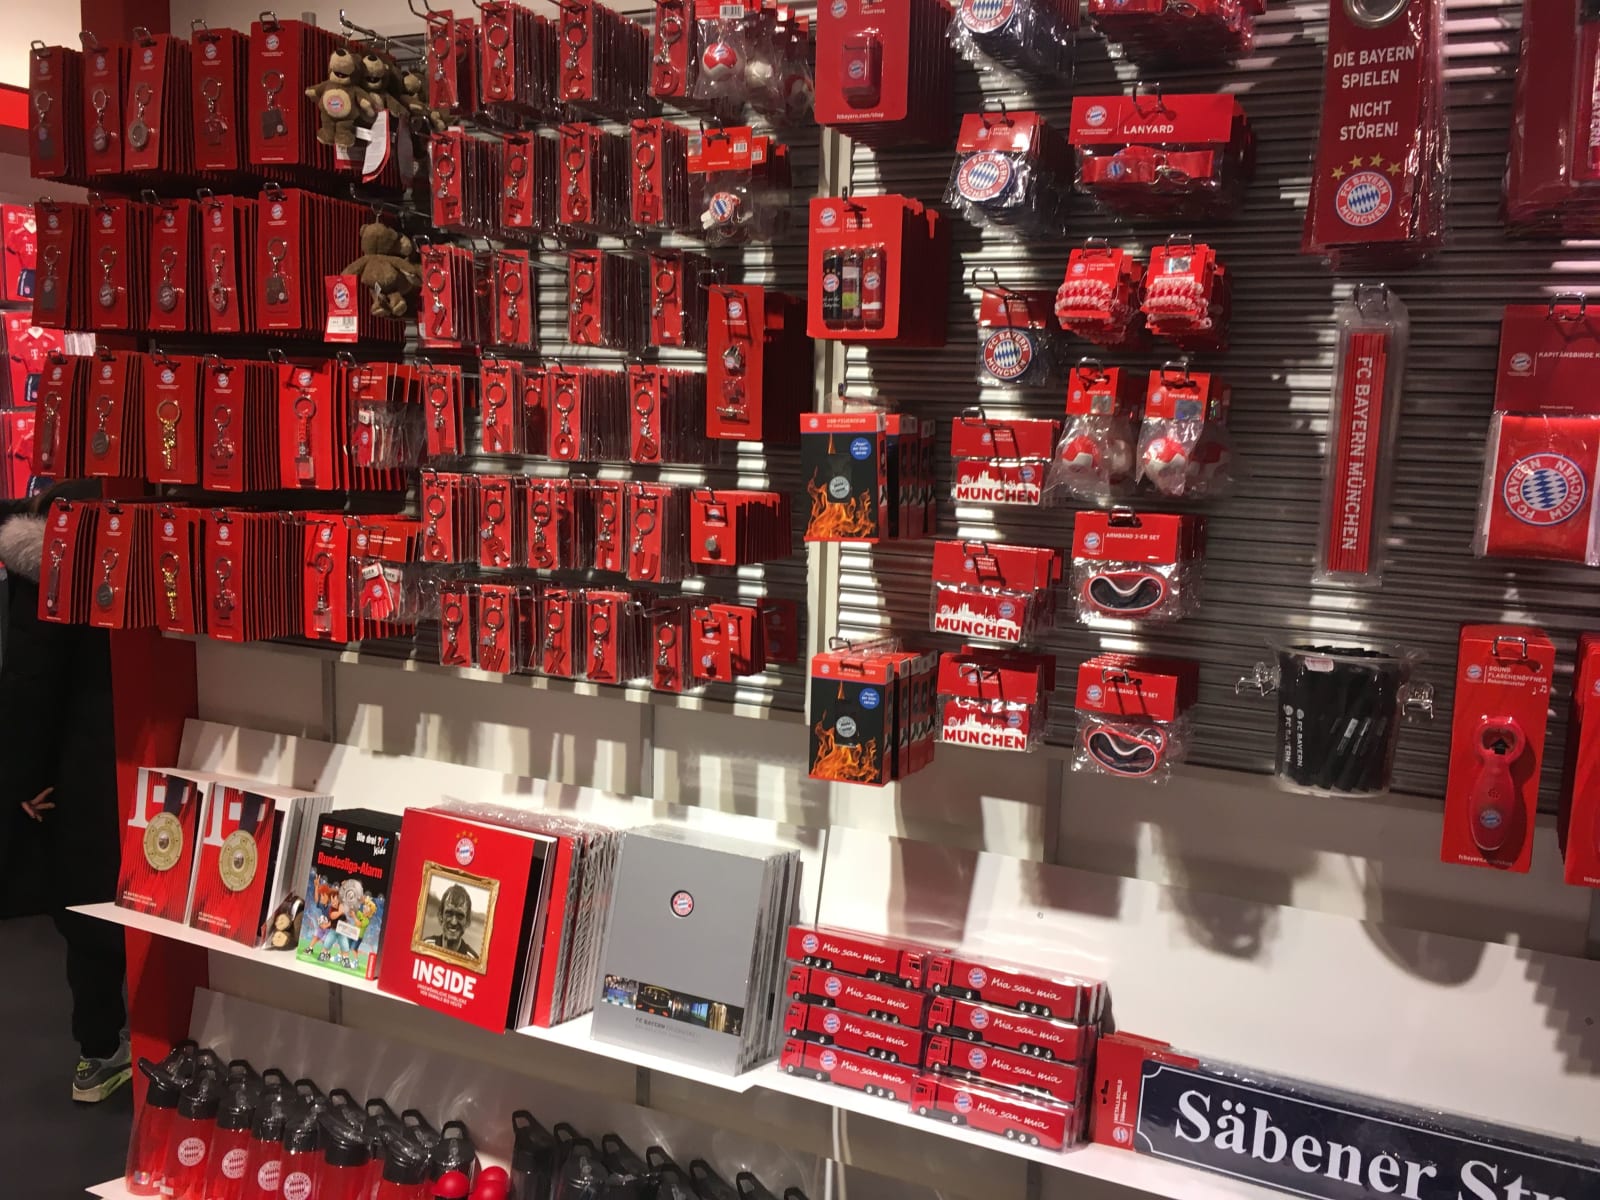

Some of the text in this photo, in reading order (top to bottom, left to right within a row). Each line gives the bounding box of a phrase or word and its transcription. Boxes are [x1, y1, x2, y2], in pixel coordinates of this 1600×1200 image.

[1333, 45, 1415, 69] DIE BAYERN
[1341, 69, 1400, 89] SPIELEN
[1349, 100, 1392, 119] NICHT
[1123, 125, 1174, 134] LANYARD
[1340, 122, 1399, 141] STÖREN!
[1341, 356, 1373, 551] FC BAYERN MÜNCHEN
[1296, 721, 1304, 767] FC BAYERN
[317, 851, 383, 879] Bundesliga-Alarm
[822, 943, 886, 964] Mia san mia
[412, 958, 477, 1000] INSIDE
[991, 977, 1061, 1001] Mia san mia
[845, 987, 909, 1010] Mia san mia
[843, 1023, 909, 1048] Mia san mia
[993, 1018, 1064, 1043] Mia san mia
[840, 1060, 906, 1085] Mia san mia
[991, 1058, 1062, 1084] Mia san mia
[976, 1102, 1049, 1130] Mia san mia
[1174, 1088, 1566, 1200] Säbener St
